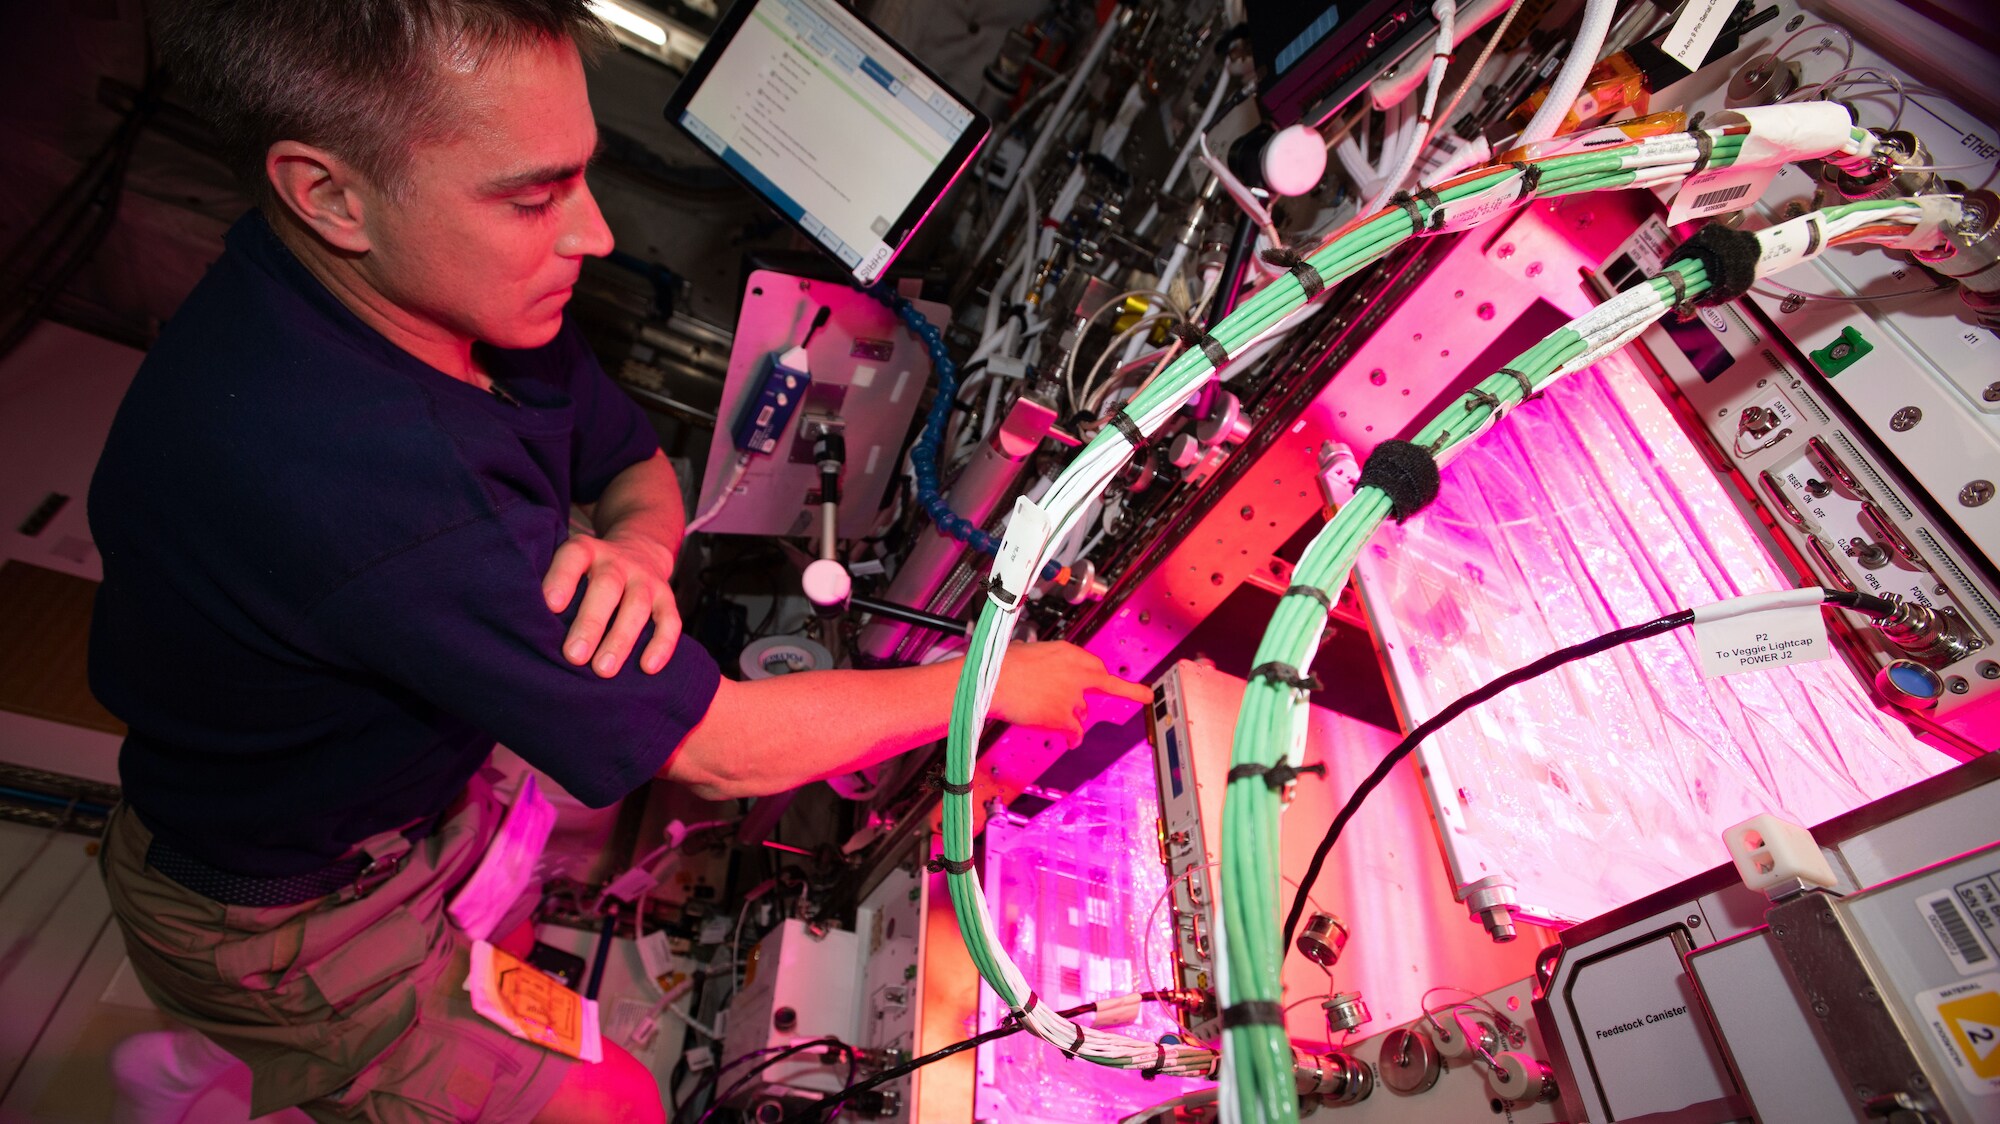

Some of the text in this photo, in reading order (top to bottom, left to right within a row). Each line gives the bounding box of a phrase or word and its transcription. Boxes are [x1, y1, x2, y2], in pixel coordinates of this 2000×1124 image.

[1683, 38, 1695, 51] Any
[1700, 5, 1712, 22] Serial
[861, 248, 888, 277] CHRIS
[1964, 333, 1979, 345] J11
[1786, 473, 1803, 490] RESET
[1803, 494, 1813, 504] ON
[1813, 508, 1826, 519] OFF
[1837, 538, 1856, 558] CLOSE
[1865, 573, 1882, 590] OPEN
[1755, 633, 1769, 642] P2
[1715, 638, 1813, 659] To Veggie Lightcap
[1740, 651, 1793, 666] POWER J2
[1961, 889, 1980, 908] S/N
[1596, 1005, 1687, 1039] Feedstock Canister
[1967, 1027, 1995, 1045] 2
